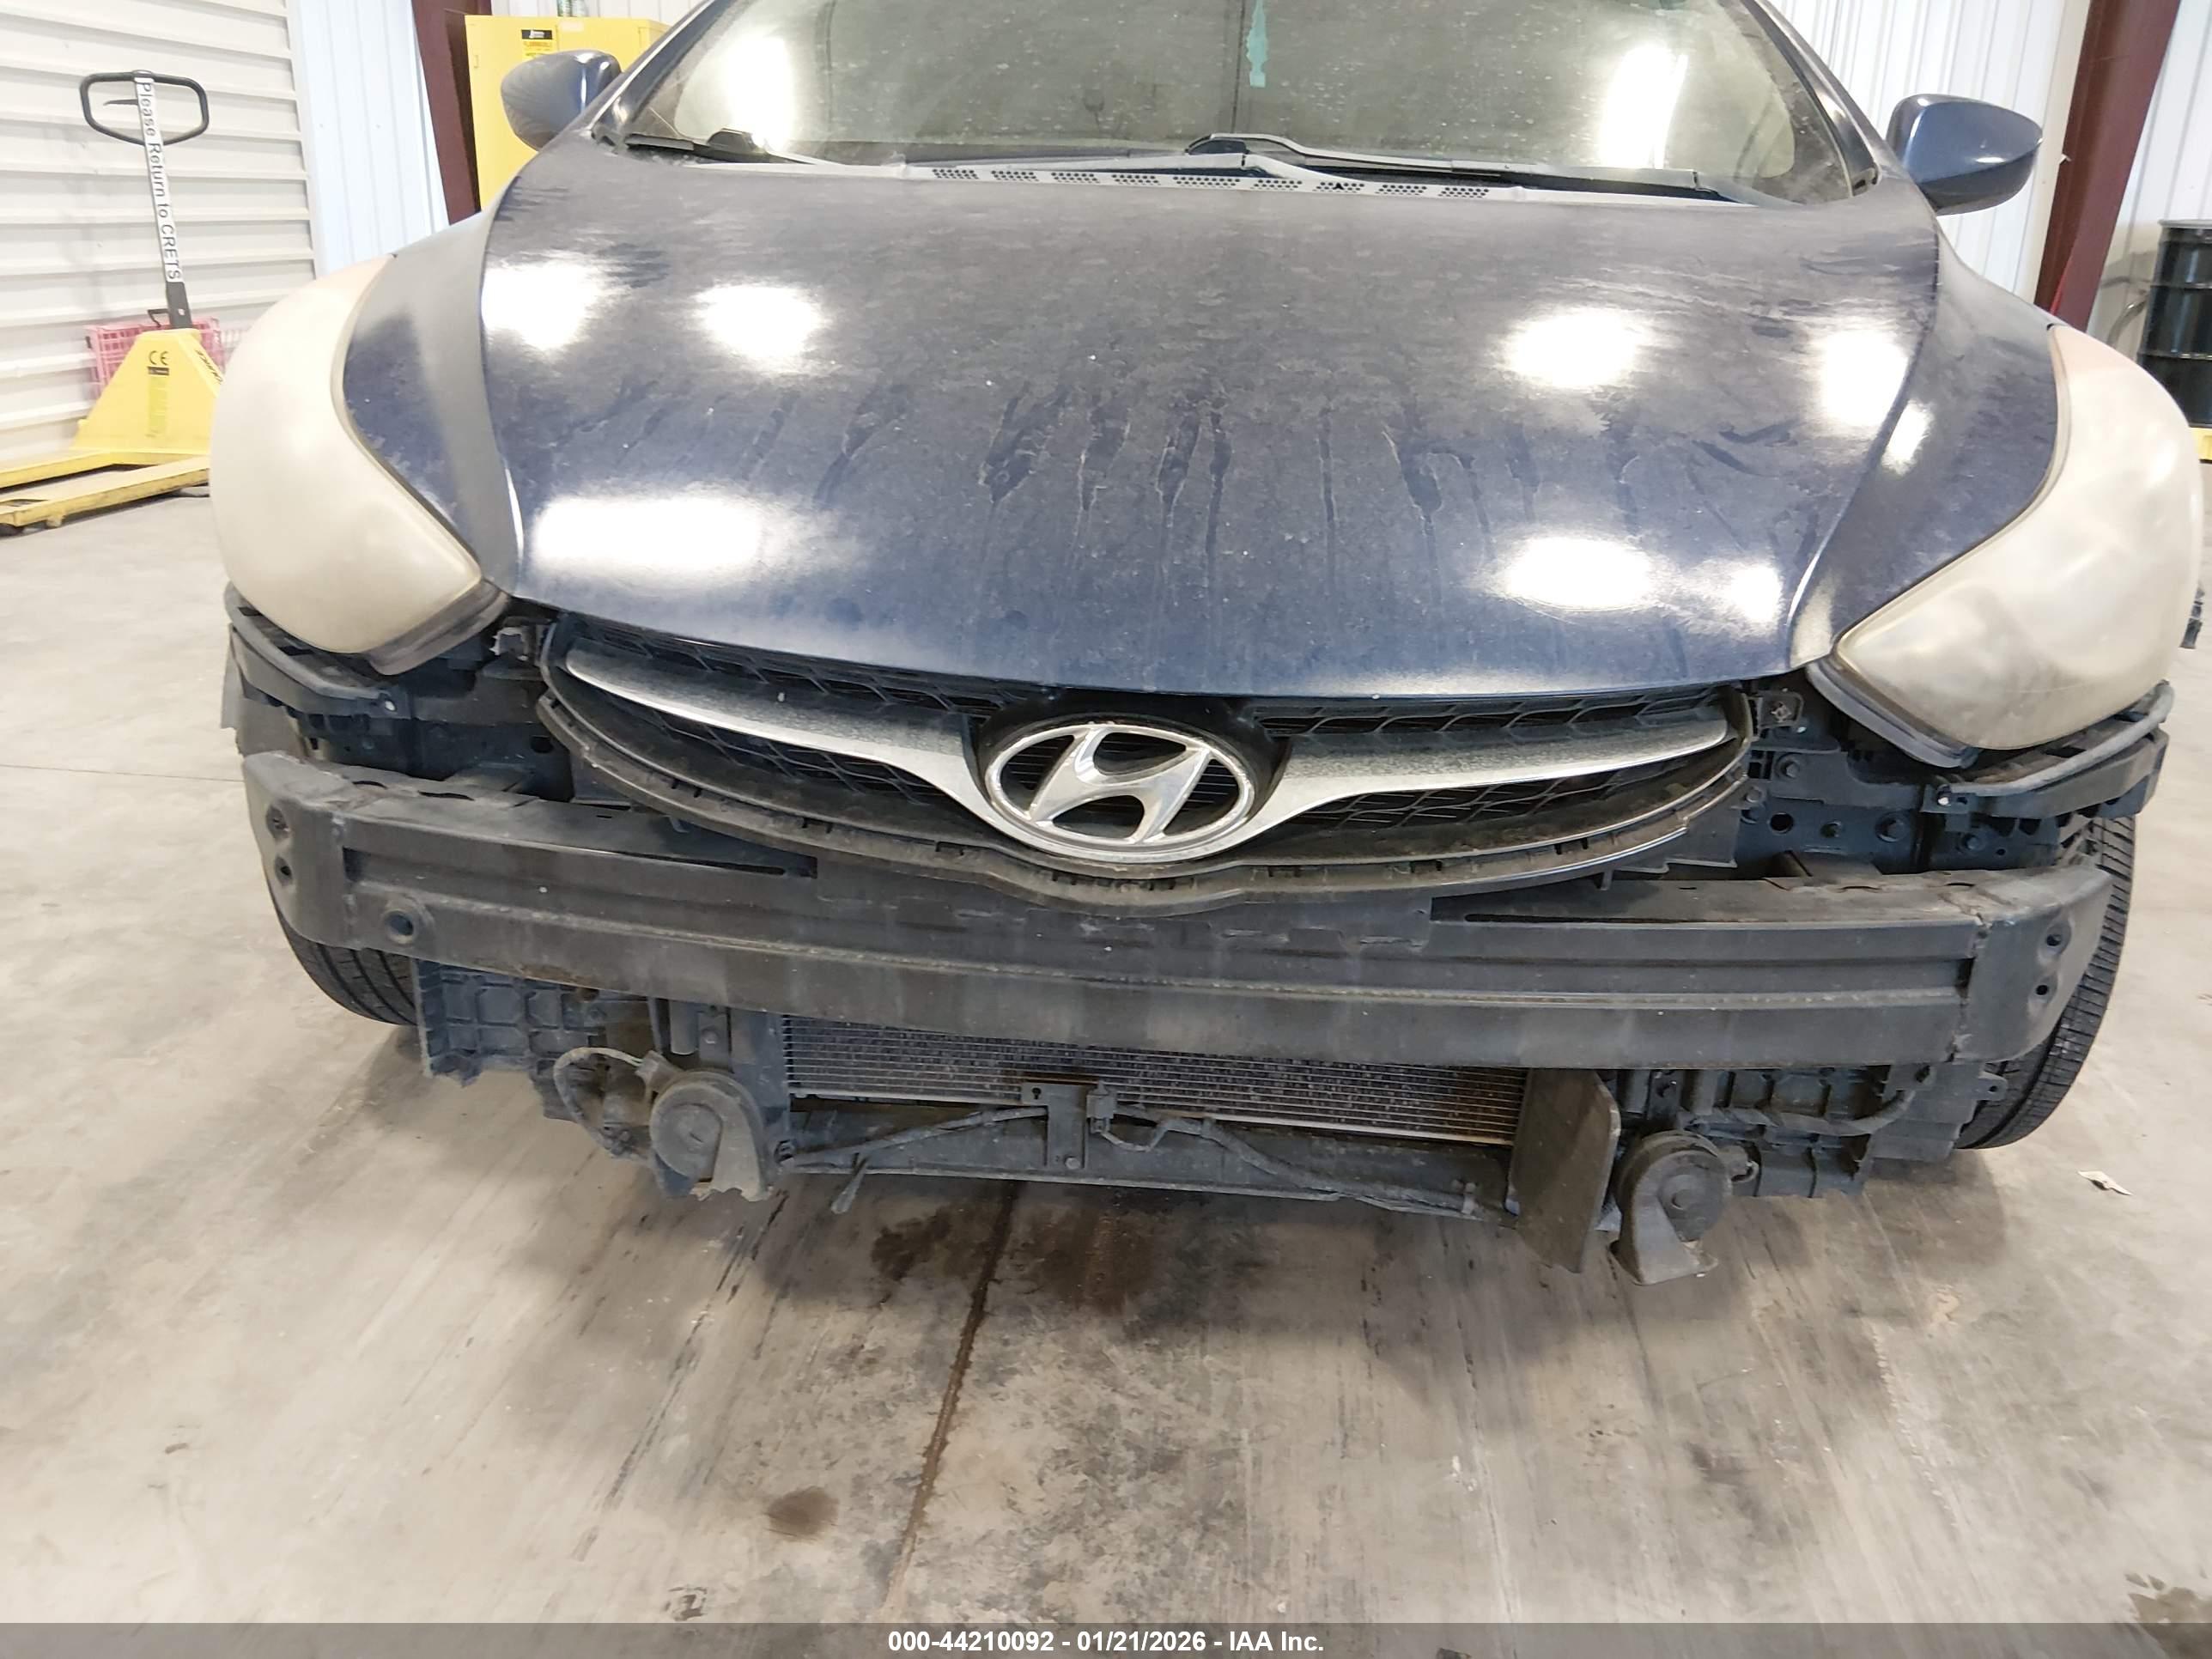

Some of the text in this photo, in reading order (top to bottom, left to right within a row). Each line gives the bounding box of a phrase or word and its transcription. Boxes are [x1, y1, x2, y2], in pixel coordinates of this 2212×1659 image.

[139, 82, 181, 279] Please Return to CRETS
